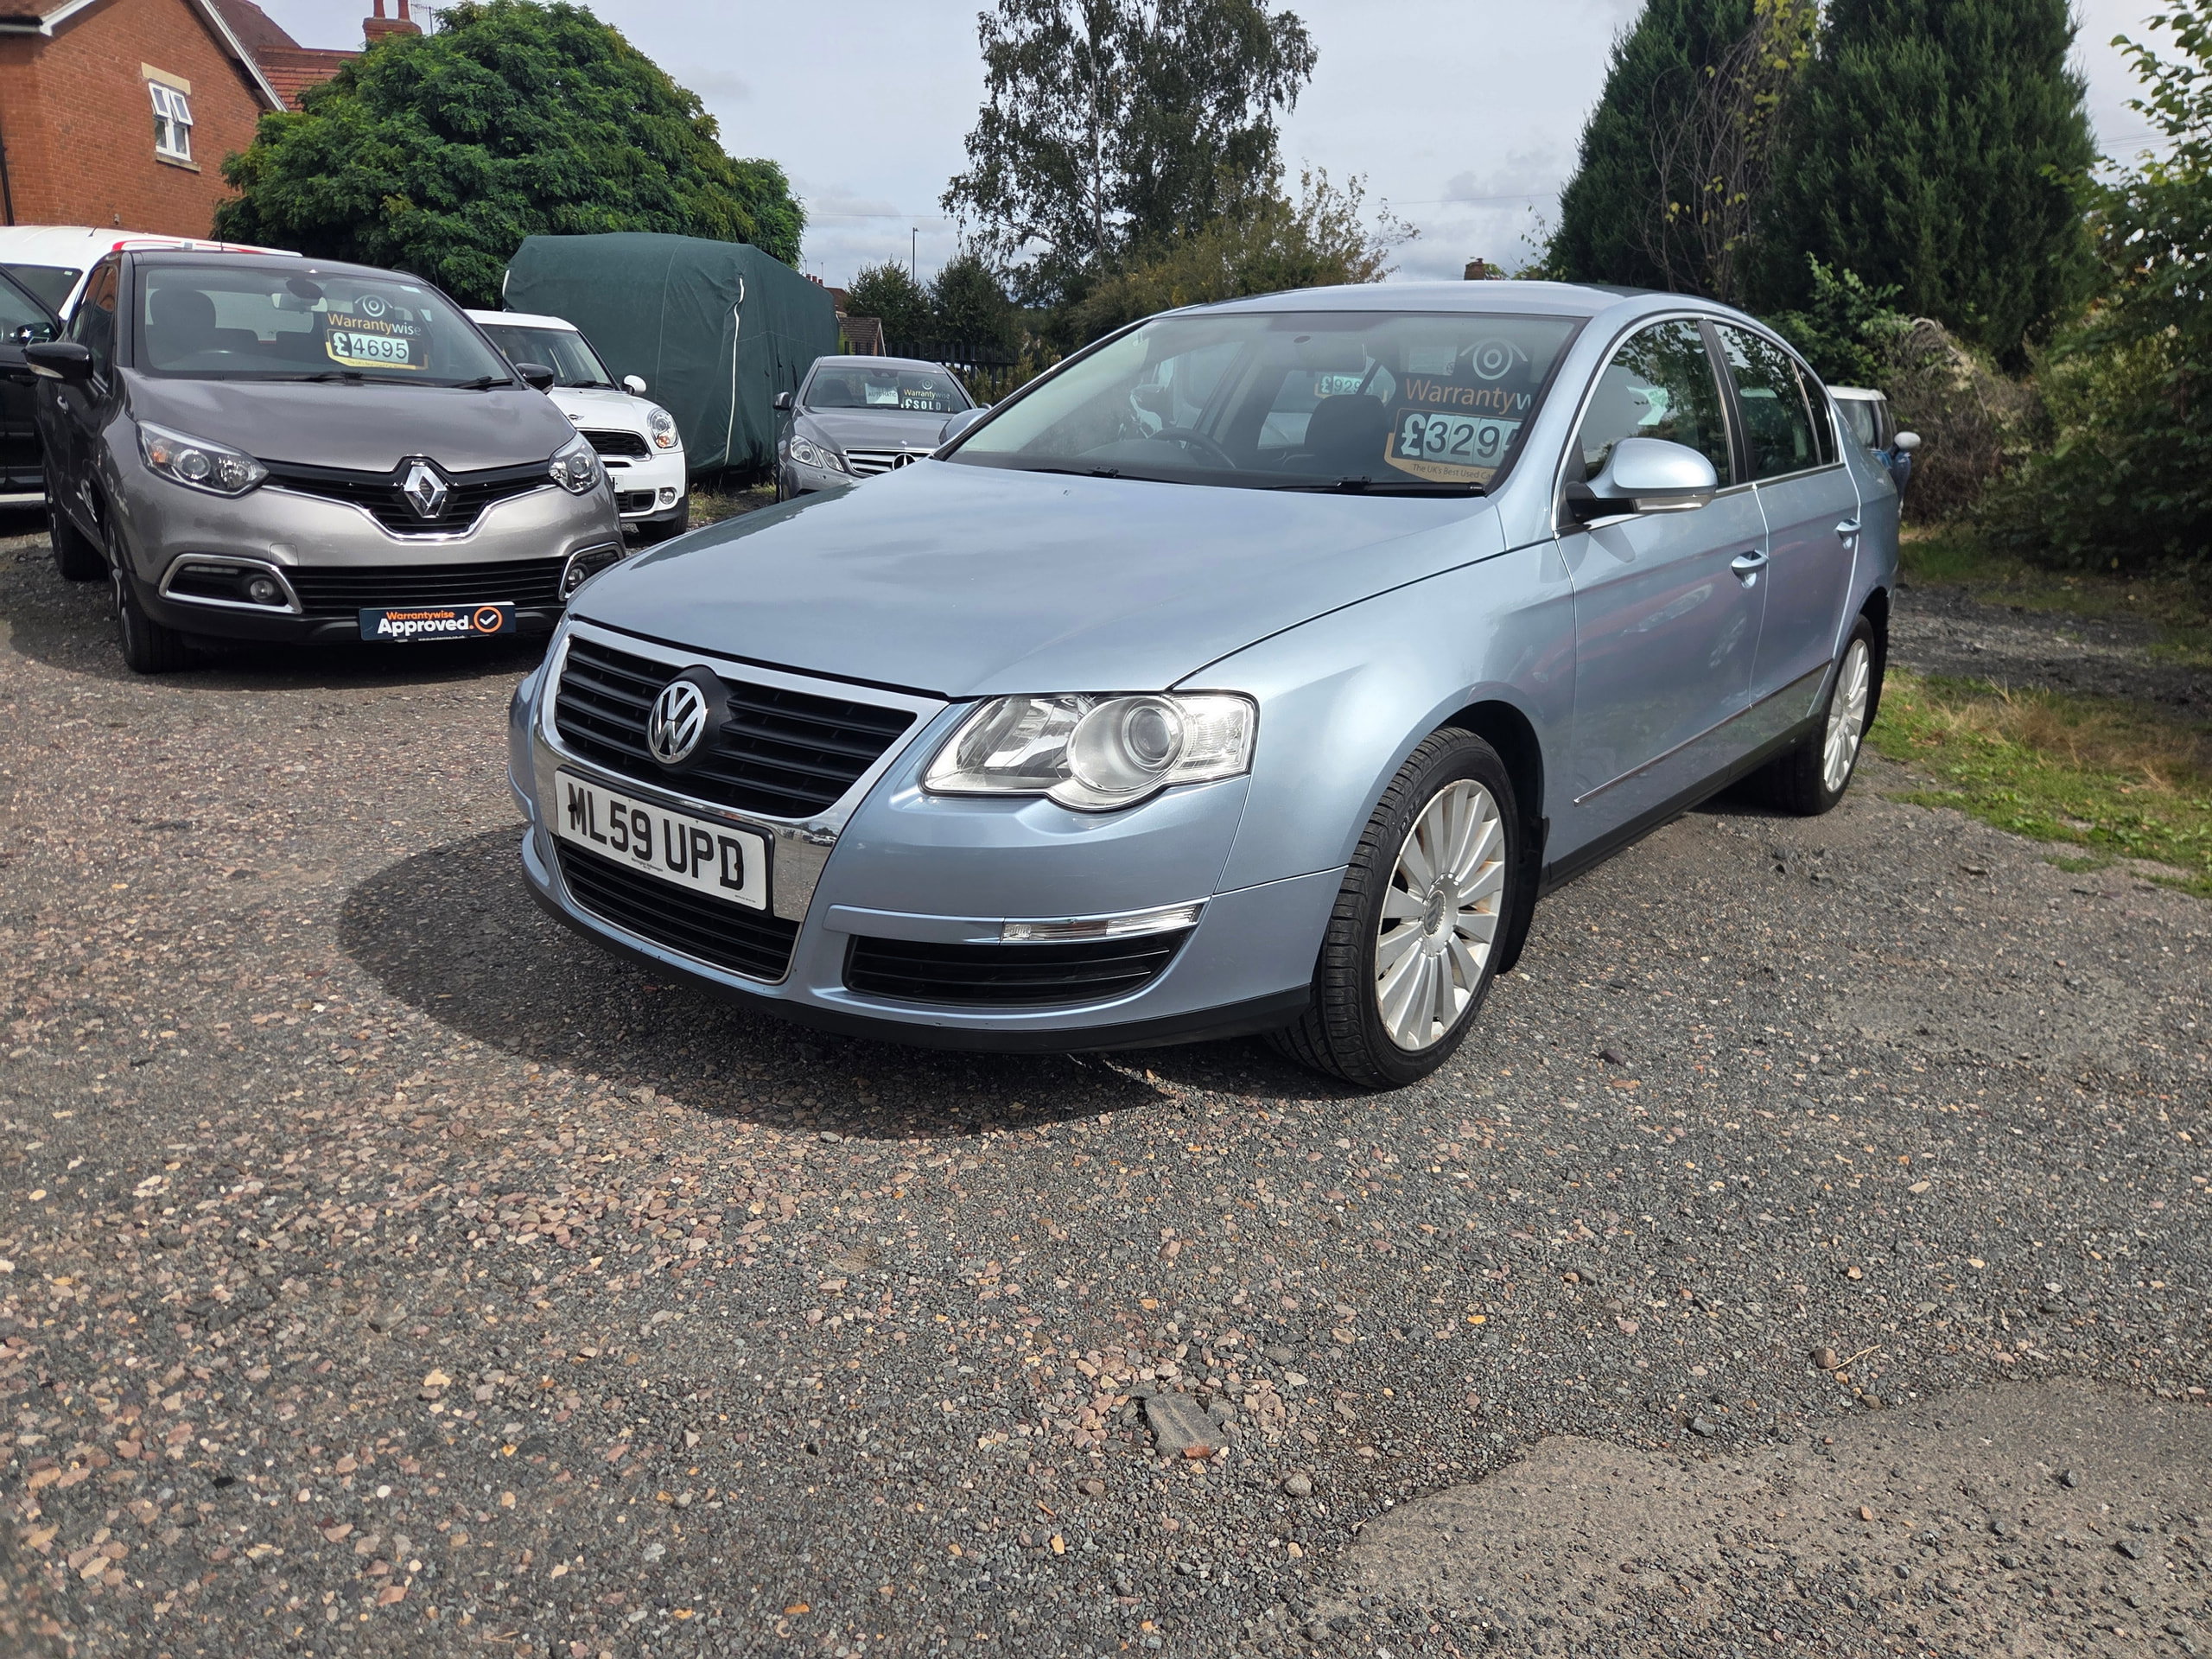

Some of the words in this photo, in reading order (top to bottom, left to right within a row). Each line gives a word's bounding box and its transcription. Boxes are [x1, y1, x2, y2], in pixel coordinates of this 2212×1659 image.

[327, 313, 422, 335] Warrantywise
[333, 332, 408, 359] £4695
[905, 398, 941, 410] £SOLD
[1413, 464, 1426, 473] The
[1444, 467, 1459, 477] Best
[1461, 469, 1479, 479] Used
[386, 610, 455, 621] Warrantywise
[567, 782, 653, 862] ML59
[663, 818, 745, 892] UPD
